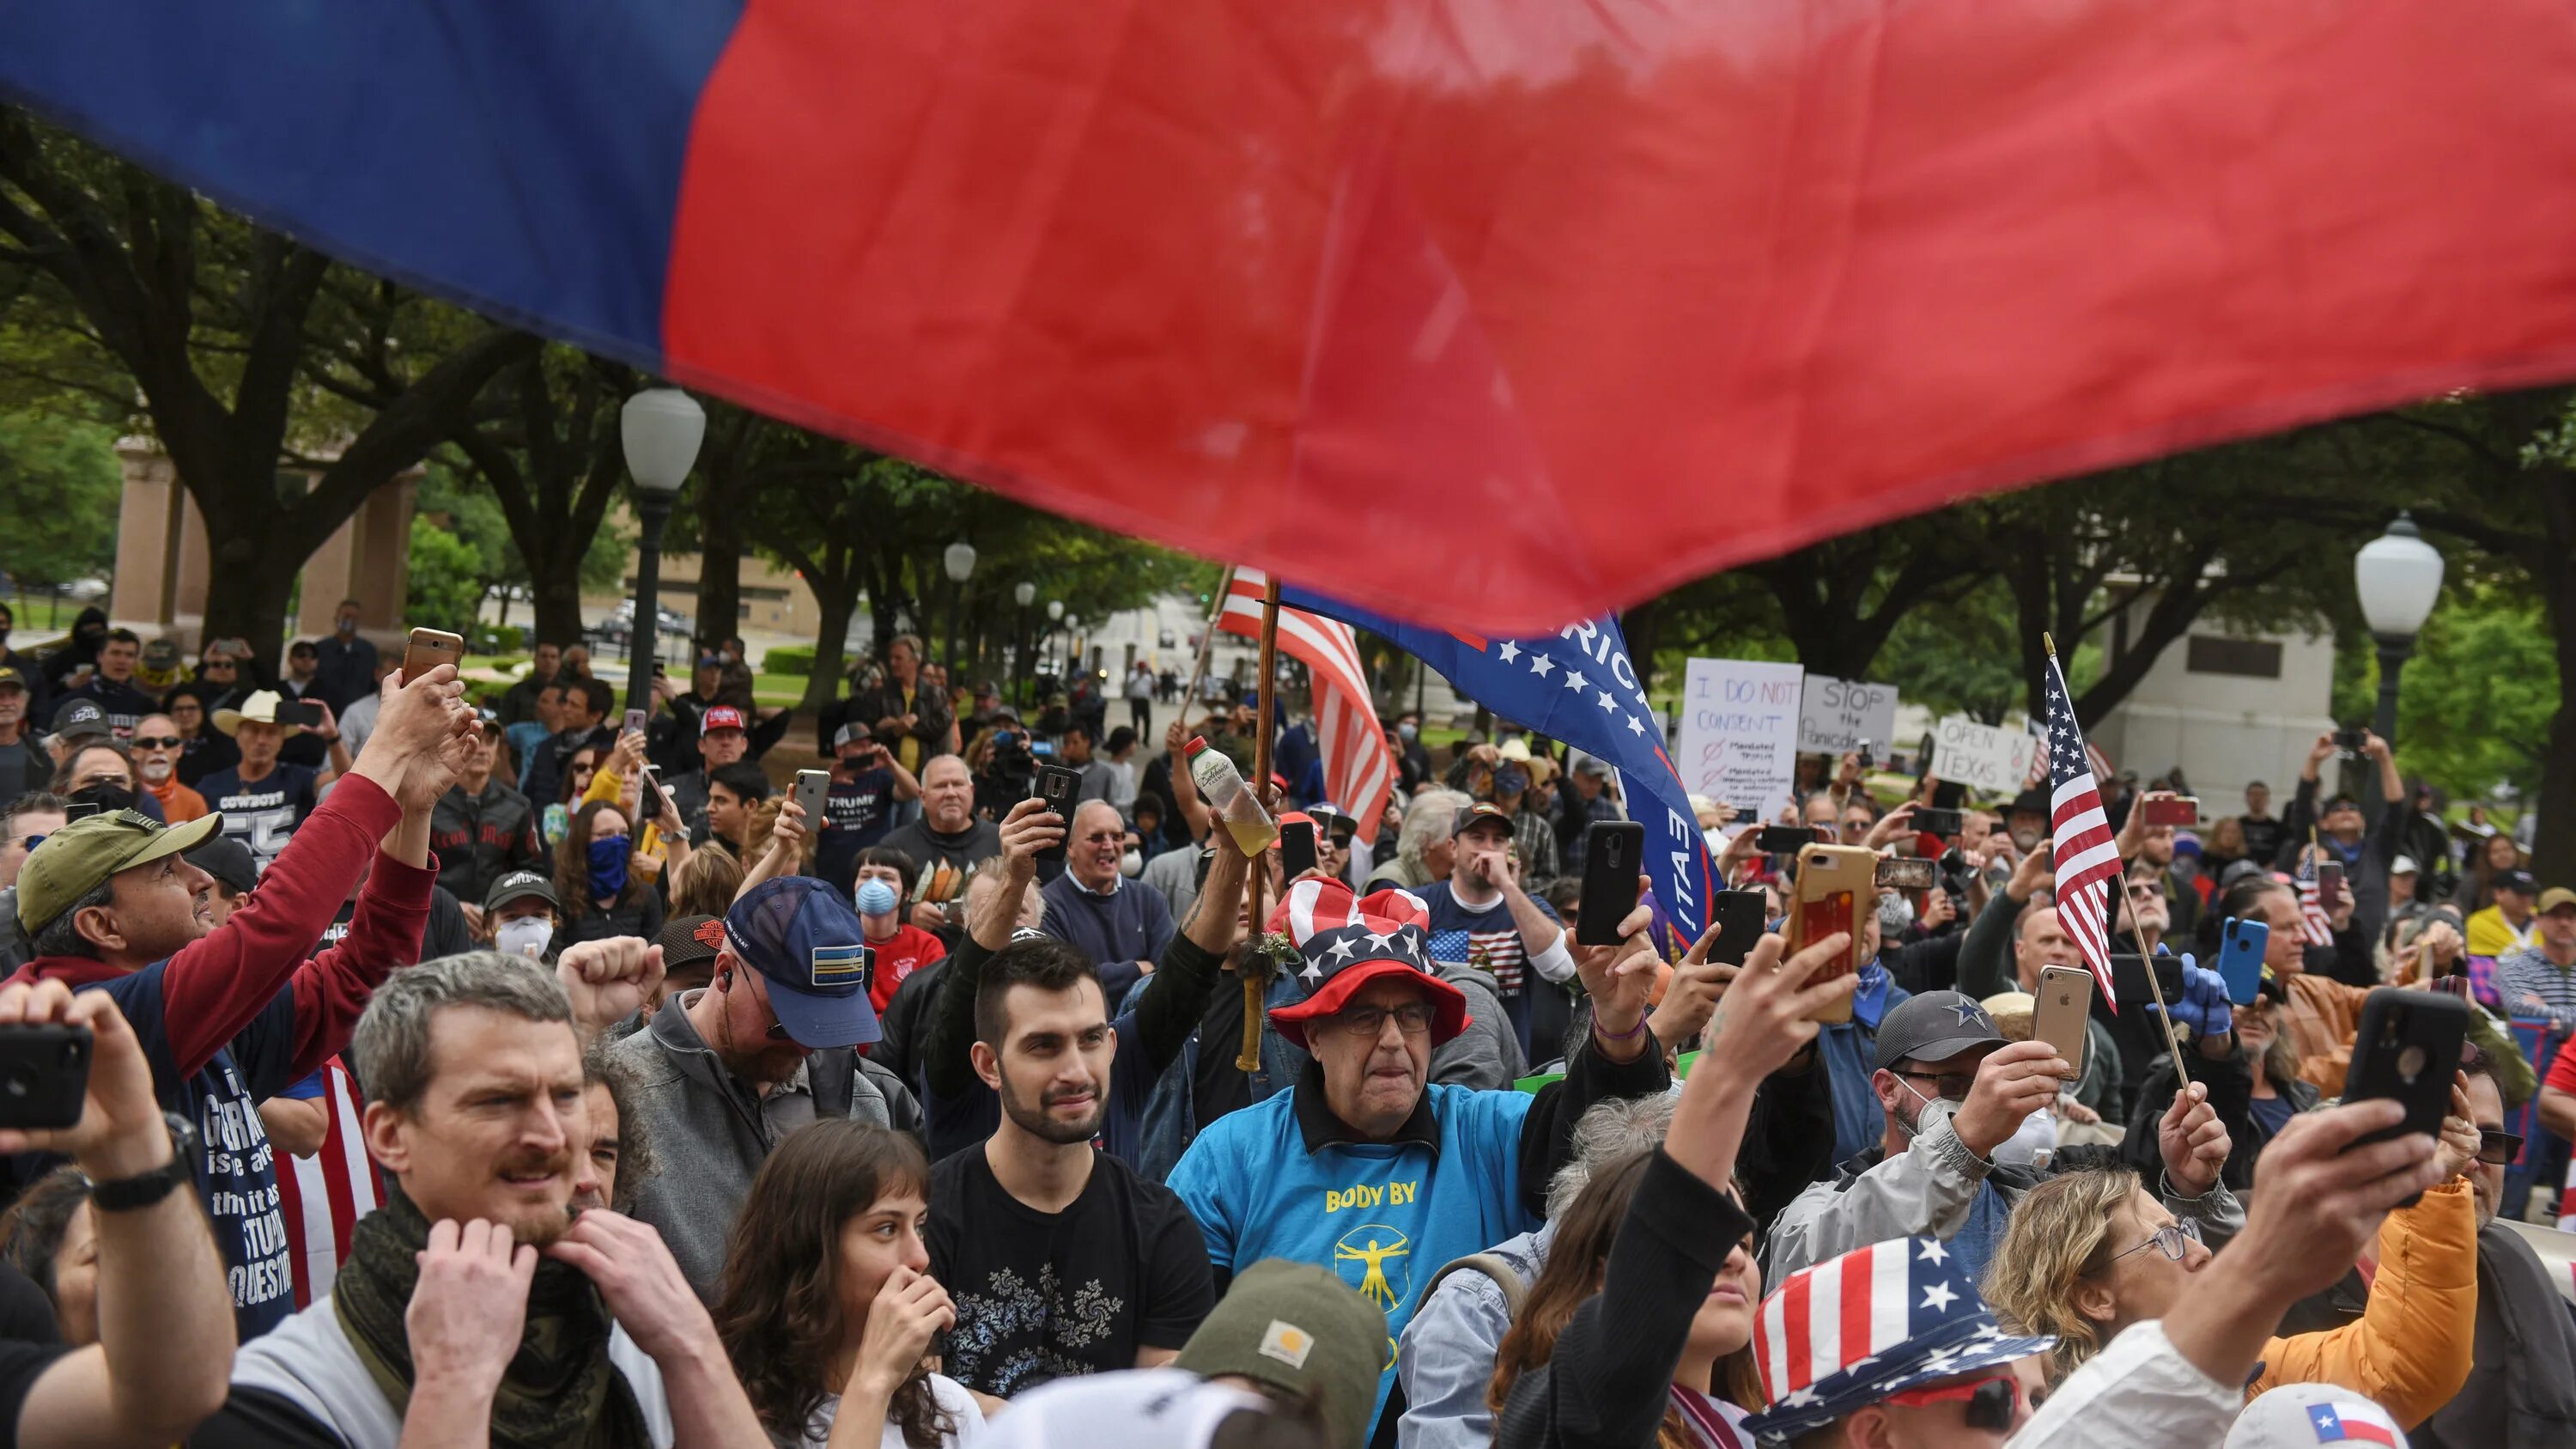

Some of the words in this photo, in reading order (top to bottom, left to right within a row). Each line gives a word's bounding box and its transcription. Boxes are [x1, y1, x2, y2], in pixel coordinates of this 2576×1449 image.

[1725, 678, 1755, 704] DO
[1760, 681, 1801, 705] NOT
[1822, 681, 1886, 712] STOP
[1697, 709, 1783, 733] CONSENT
[1840, 712, 1862, 728] the
[1945, 722, 1996, 750] OPEN
[1939, 744, 1998, 785] TEXAS
[220, 790, 285, 809] COWBOYS
[828, 794, 876, 809] TRUMP
[1325, 1184, 1384, 1214] BODY
[1389, 1180, 1417, 1206] BY
